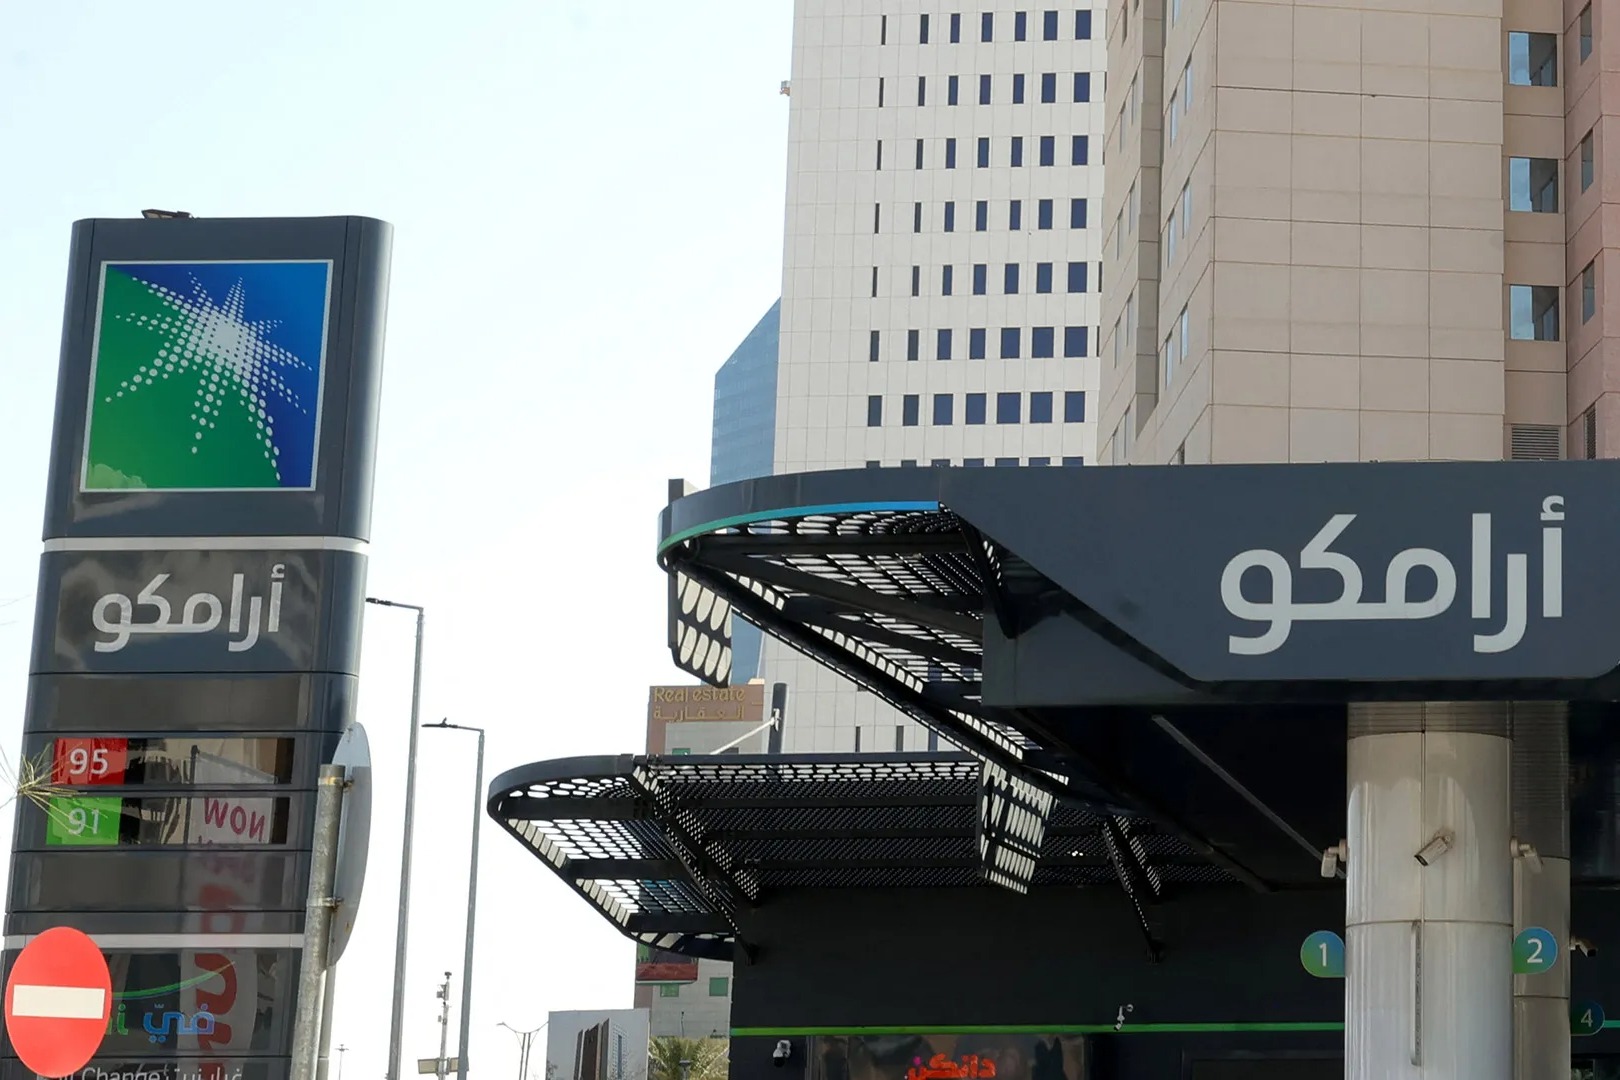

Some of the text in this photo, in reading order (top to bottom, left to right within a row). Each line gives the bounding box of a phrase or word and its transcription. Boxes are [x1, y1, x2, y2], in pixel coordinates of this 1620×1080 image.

[1220, 494, 1565, 656] أرامكو
[92, 563, 285, 653] أرامكو
[653, 686, 745, 703] Real estate
[69, 748, 109, 775] 95
[68, 807, 99, 836] 91
[1318, 942, 1328, 967] 1
[1526, 938, 1544, 964] 2
[1580, 1008, 1593, 1027] 4
